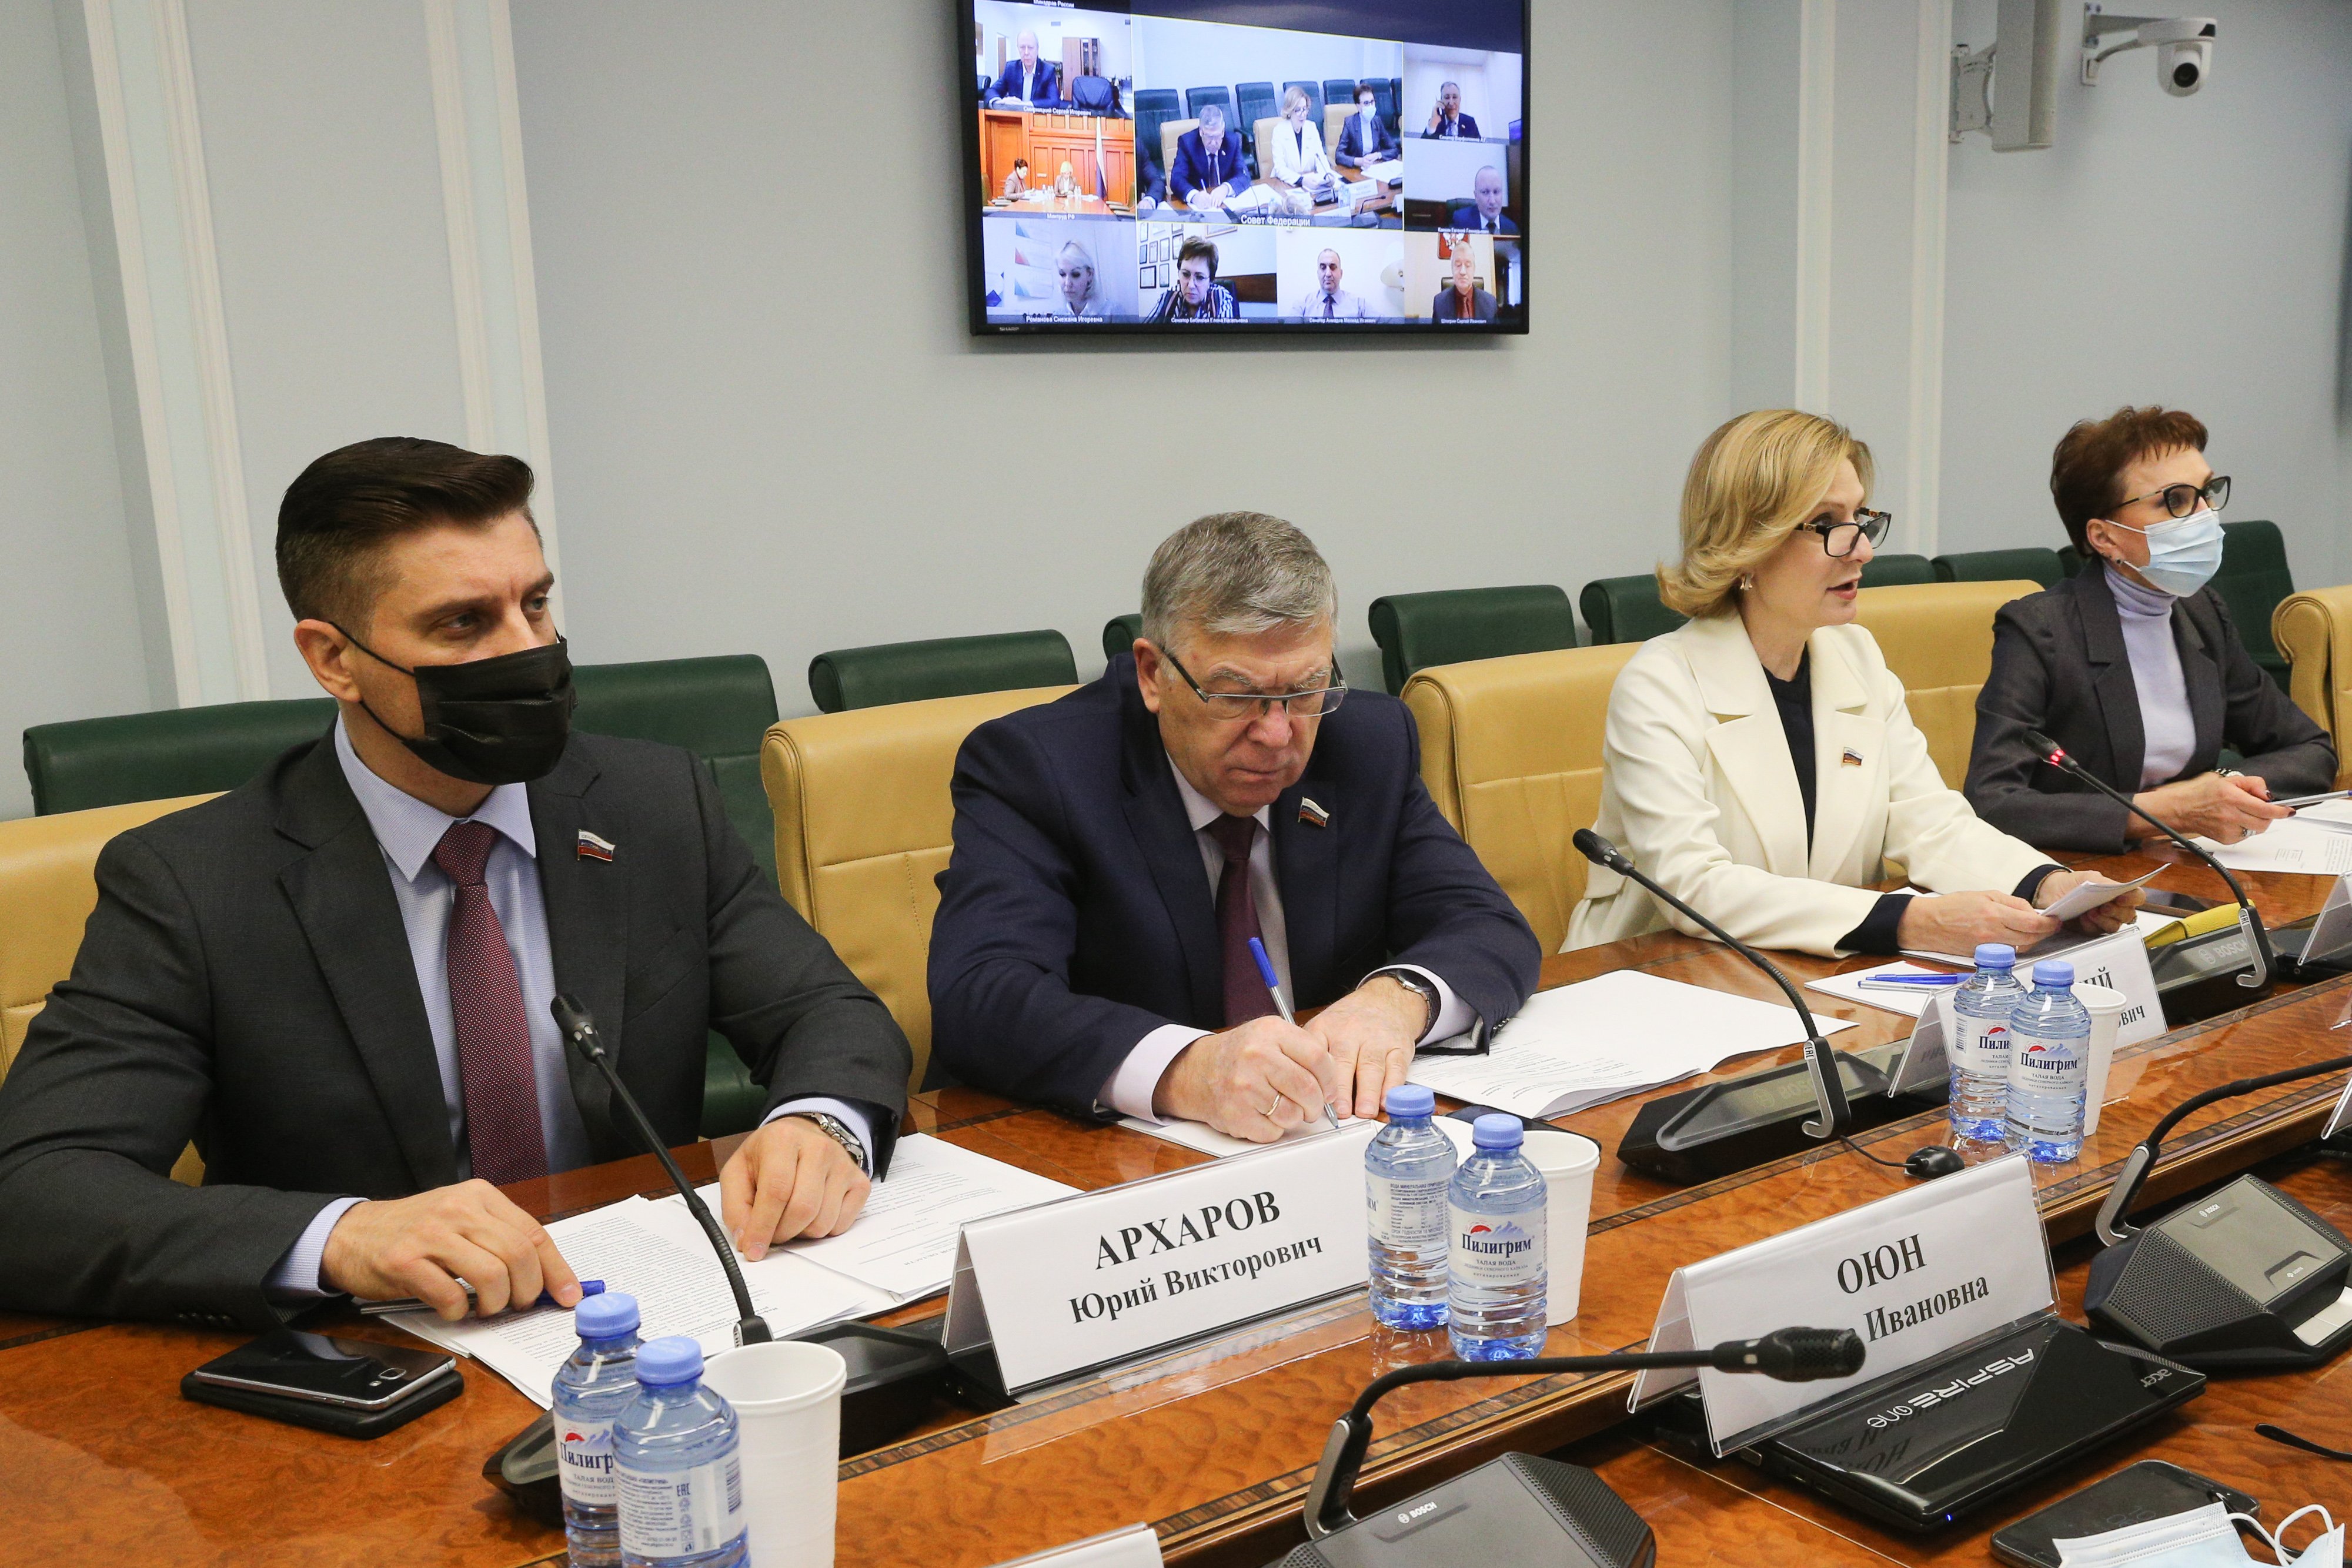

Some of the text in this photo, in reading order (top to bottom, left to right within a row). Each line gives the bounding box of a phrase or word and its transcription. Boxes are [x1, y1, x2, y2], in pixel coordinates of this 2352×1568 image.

[1241, 214, 1311, 227] Совет Федерации
[1979, 1036, 2009, 1049] Пили
[2020, 1052, 2077, 1074] Пилигрим
[1095, 1191, 1281, 1270] АРХАРОВ
[1462, 1233, 1531, 1258] Пилигрим
[1838, 1233, 1927, 1295] ОЮН
[1068, 1236, 1324, 1324] Юрий Викторович
[1863, 1276, 1989, 1343] Ивановна
[1908, 1348, 2034, 1408] ASPIRE
[2140, 1369, 2172, 1388] acer
[574, 1473, 594, 1482] ТАЛАЯ
[1409, 1501, 1437, 1518] BOSCH
